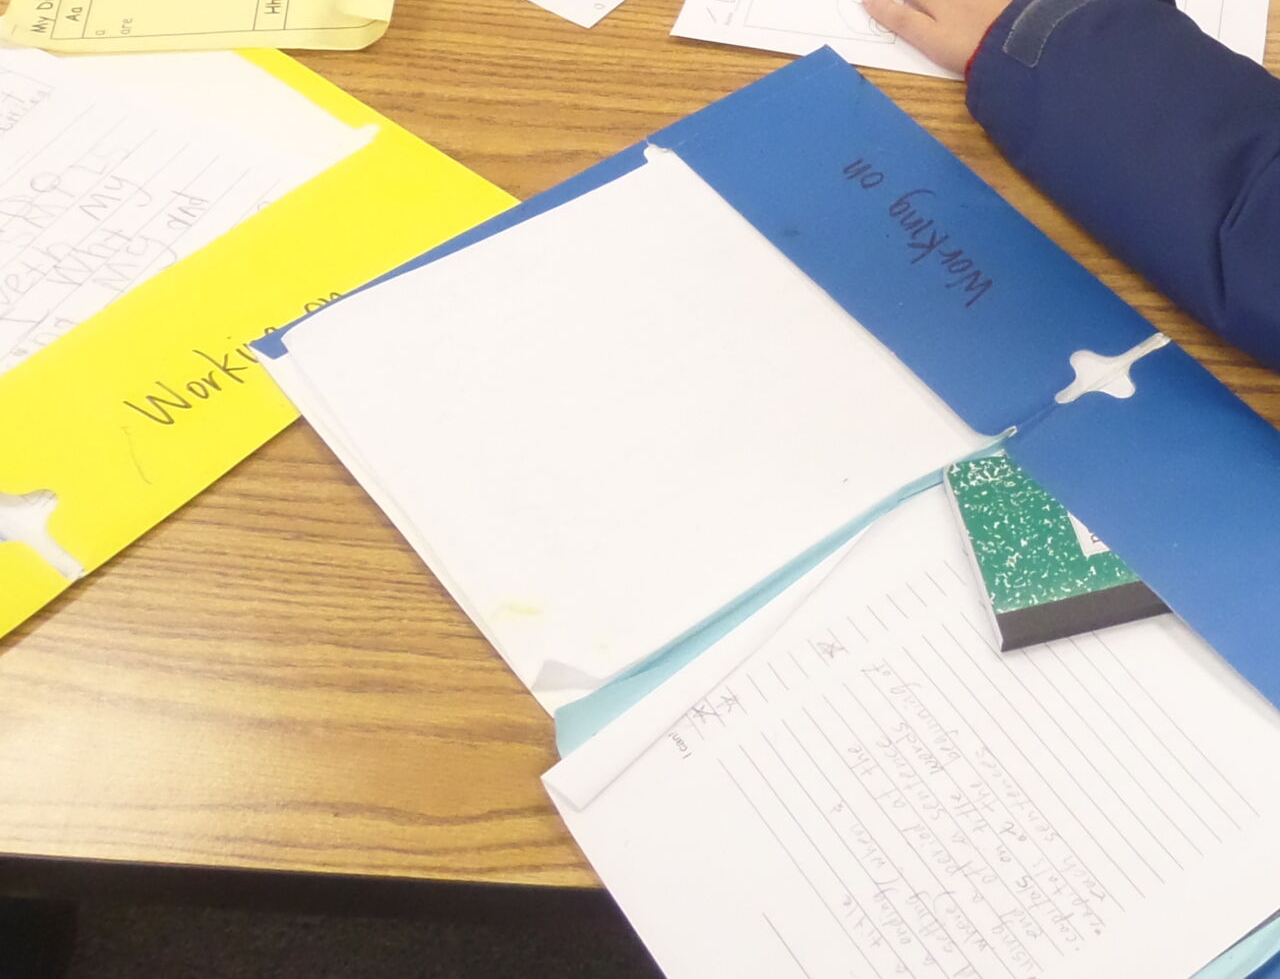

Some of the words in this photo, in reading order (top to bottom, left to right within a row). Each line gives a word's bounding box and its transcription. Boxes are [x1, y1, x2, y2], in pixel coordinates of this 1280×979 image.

[31, 16, 55, 36] My
[65, 6, 82, 22] Aa
[120, 17, 134, 35] are
[842, 158, 884, 189] on
[889, 188, 993, 307] Working
[838, 745, 879, 784] the
[876, 733, 948, 820] sentence
[969, 781, 1002, 813] the
[900, 814, 972, 876] period
[996, 844, 1012, 863] on
[991, 917, 1038, 970] using
